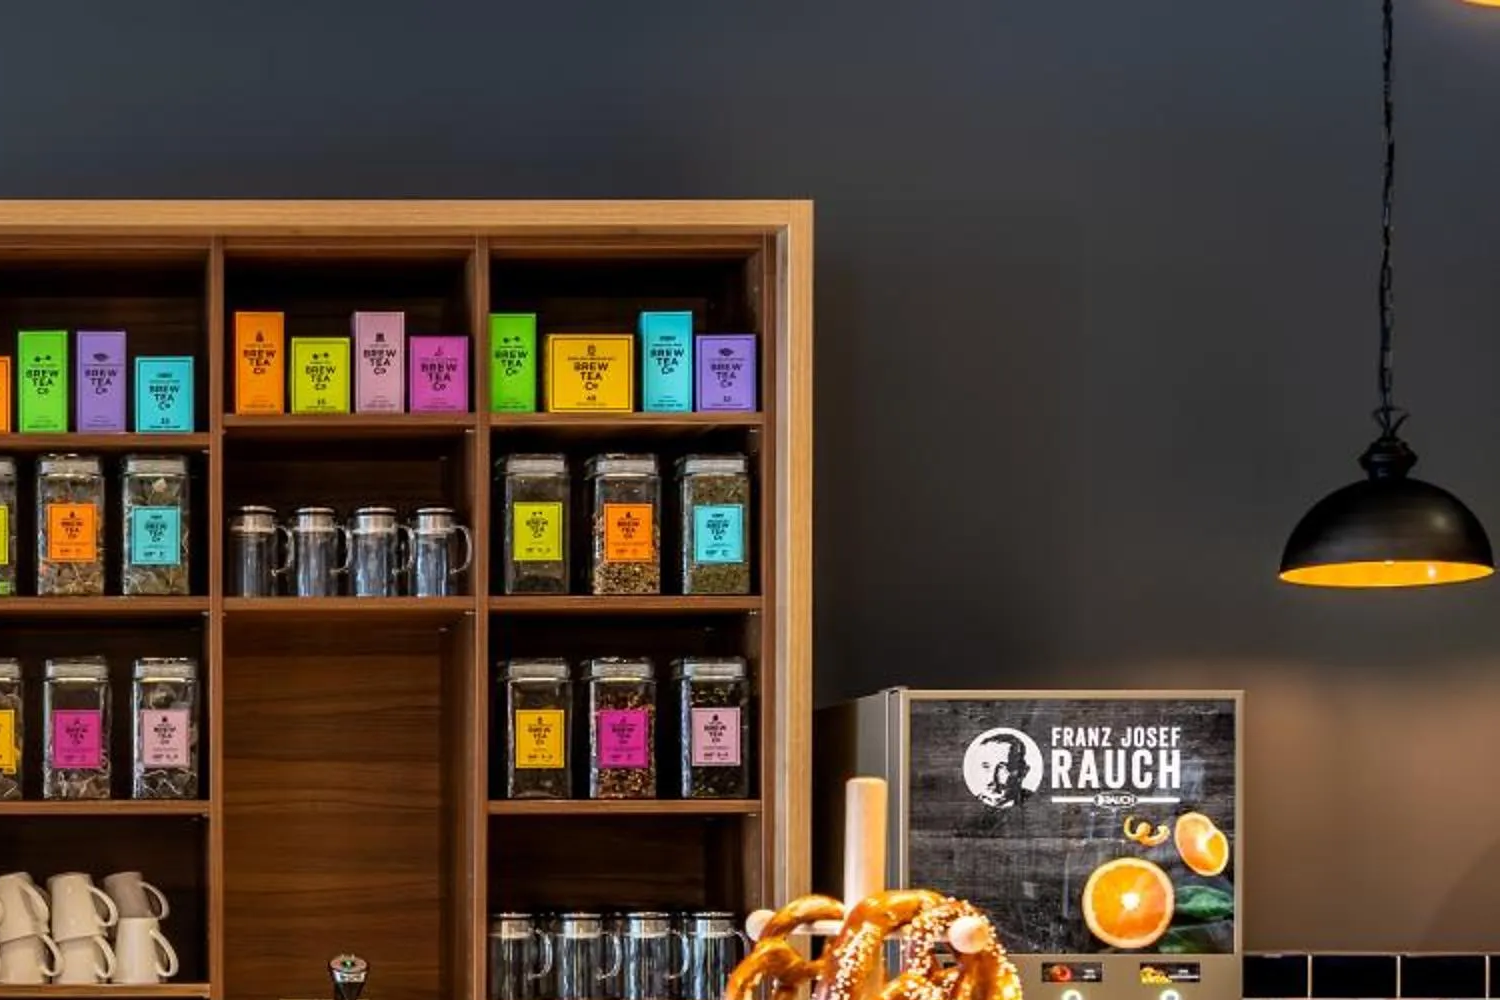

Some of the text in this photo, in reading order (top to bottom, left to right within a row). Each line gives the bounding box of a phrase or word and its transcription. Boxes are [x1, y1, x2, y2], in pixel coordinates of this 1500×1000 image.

[363, 350, 396, 358] BREW
[495, 350, 528, 359] BREW
[650, 348, 685, 357] BREW
[369, 358, 391, 367] TEA
[501, 359, 523, 368] TEA
[656, 357, 678, 366] TEA
[305, 366, 336, 374] BREW
[421, 363, 457, 373] BREW
[574, 362, 608, 372] BREW
[26, 369, 60, 378] BREW
[84, 369, 118, 378] BREW
[428, 373, 451, 382] TEA
[580, 372, 603, 381] TEA
[716, 371, 736, 380] TEA
[32, 378, 53, 386] TEA
[91, 378, 112, 386] TEA
[311, 374, 331, 383] TEA
[149, 385, 180, 394] BREW
[155, 394, 174, 402] TEA
[1051, 726, 1181, 748] FRANZ JOSEF
[1051, 748, 1181, 789] RAUCH
